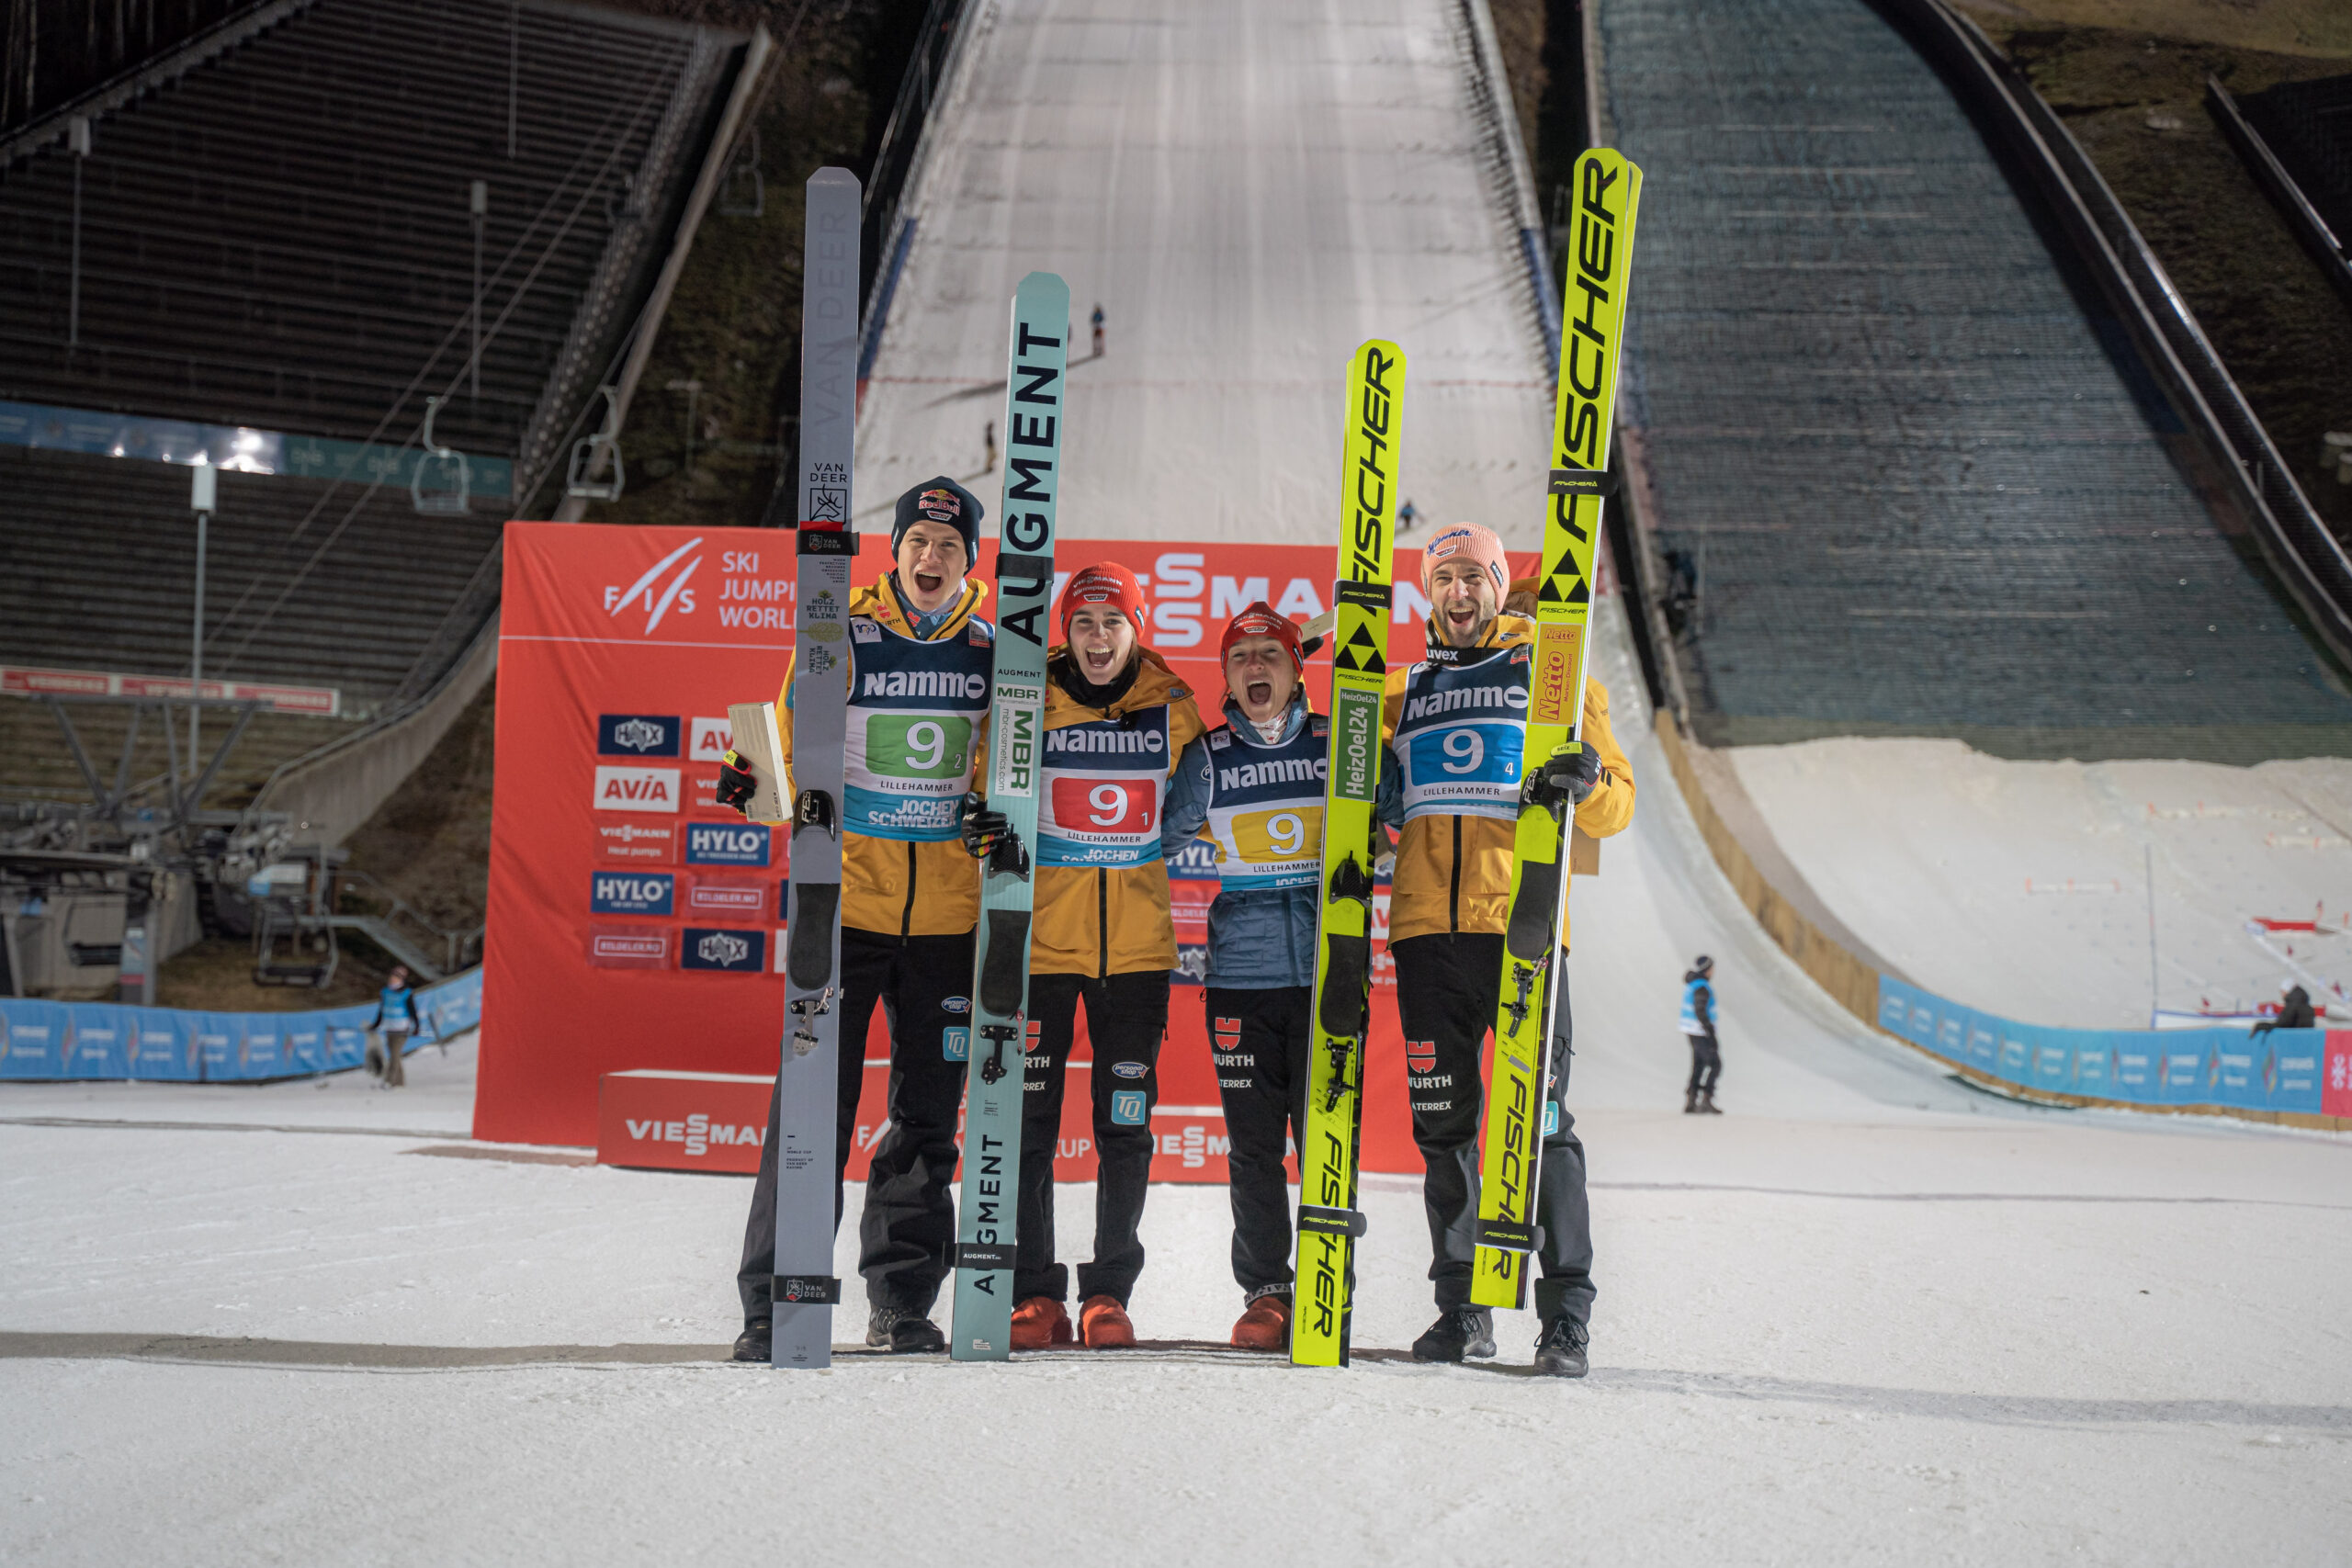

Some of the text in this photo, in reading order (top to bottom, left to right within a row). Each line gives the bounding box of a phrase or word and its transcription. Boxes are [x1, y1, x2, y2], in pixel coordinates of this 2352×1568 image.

[814, 462, 843, 472] VAN
[809, 472, 847, 483] DEER
[1001, 321, 1061, 648] AUGMENT
[918, 499, 940, 510] Red
[941, 500, 960, 516] Bull
[721, 551, 759, 573] SKI
[1544, 628, 1577, 640] Netto
[822, 650, 831, 671] HOLZ
[1426, 649, 1459, 661] uvex
[997, 669, 1042, 679] AUGMENT
[1337, 673, 1384, 684] FISCHER
[864, 671, 986, 699] Nammo
[997, 686, 1039, 700] MBR
[1539, 651, 1565, 721] Netto
[1340, 692, 1377, 705] HeizOel24
[1407, 685, 1530, 722] Nammo
[904, 720, 945, 771] 9
[998, 708, 1009, 792] mbr-cosmetics.com
[1011, 709, 1034, 790] MBR
[1046, 729, 1163, 753] Nammo
[1345, 706, 1369, 795] HeizOel24
[1442, 728, 1485, 774] 9
[954, 753, 962, 770] 2
[1504, 761, 1515, 776] 4
[880, 781, 954, 792] LILLEHAMMER
[1423, 786, 1500, 796] LILLEHAMMER
[801, 791, 811, 824] FES
[896, 799, 960, 817] JOCHEN
[1089, 783, 1129, 827] 9
[867, 811, 957, 829] SCHWEIZER
[1141, 811, 1148, 826] 1
[1068, 831, 1142, 843] LILLEHAMMER
[1266, 812, 1306, 855] 9
[1083, 849, 1139, 861] JOCHEN
[947, 1032, 965, 1057] TQ
[1024, 1056, 1050, 1068] RTH
[1023, 1081, 1046, 1091] RREX
[1118, 1096, 1141, 1122] TQ
[1416, 1101, 1452, 1111] TERREX
[1492, 1073, 1527, 1280] FISCHR
[974, 1134, 1003, 1296] AGMENT
[1303, 1216, 1342, 1225] FISCHER
[1313, 1130, 1343, 1338] FISHER
[1484, 1231, 1522, 1241] FISCHER
